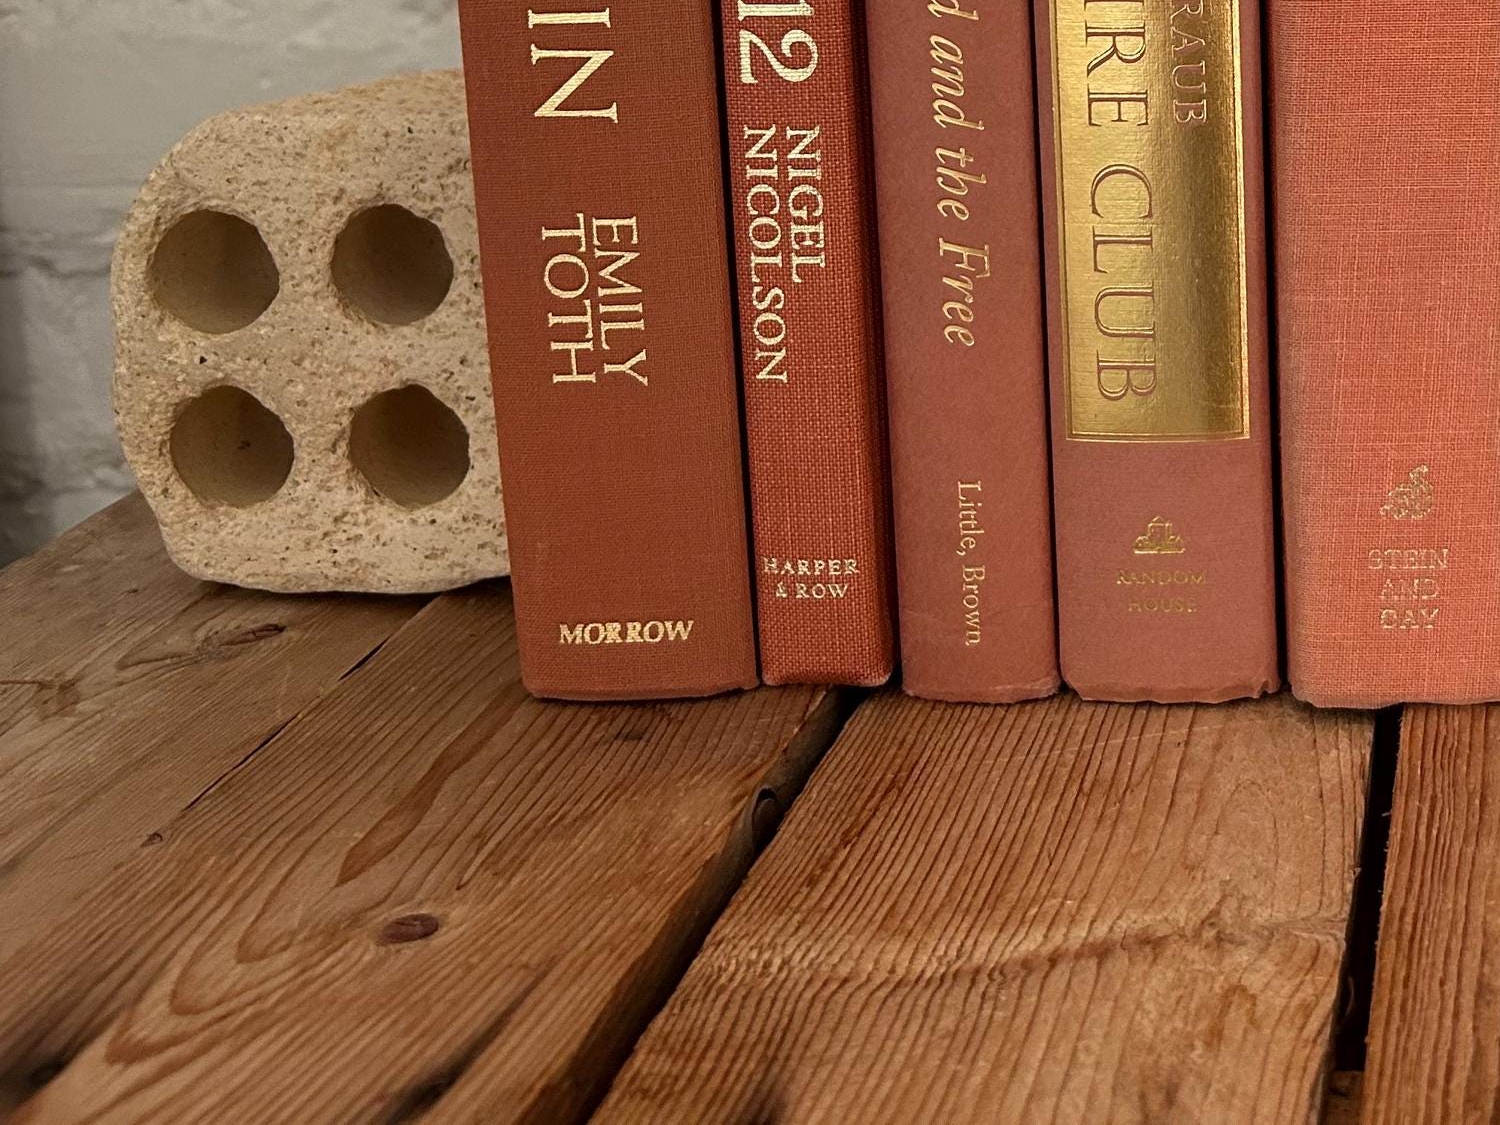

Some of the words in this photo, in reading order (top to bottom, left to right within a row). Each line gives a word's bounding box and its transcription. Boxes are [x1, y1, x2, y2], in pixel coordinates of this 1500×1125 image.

[929, 35, 984, 132] and
[787, 125, 827, 283] NIGEL
[935, 146, 987, 221] the
[744, 125, 788, 383] NICOLSON
[1089, 163, 1158, 403] CLUB
[541, 213, 597, 386] TOTH
[591, 214, 649, 386] EMILY
[937, 237, 992, 348] Free
[956, 480, 984, 556] Little,
[763, 557, 860, 575] HARPER
[776, 581, 788, 598] &
[796, 583, 849, 598] ROW
[1117, 569, 1206, 586] RANDOM
[1368, 549, 1450, 569] STEIN
[1380, 578, 1441, 600] AND
[558, 621, 694, 644] MORROW
[960, 564, 989, 646] Brown
[1127, 598, 1198, 613] HOUSE
